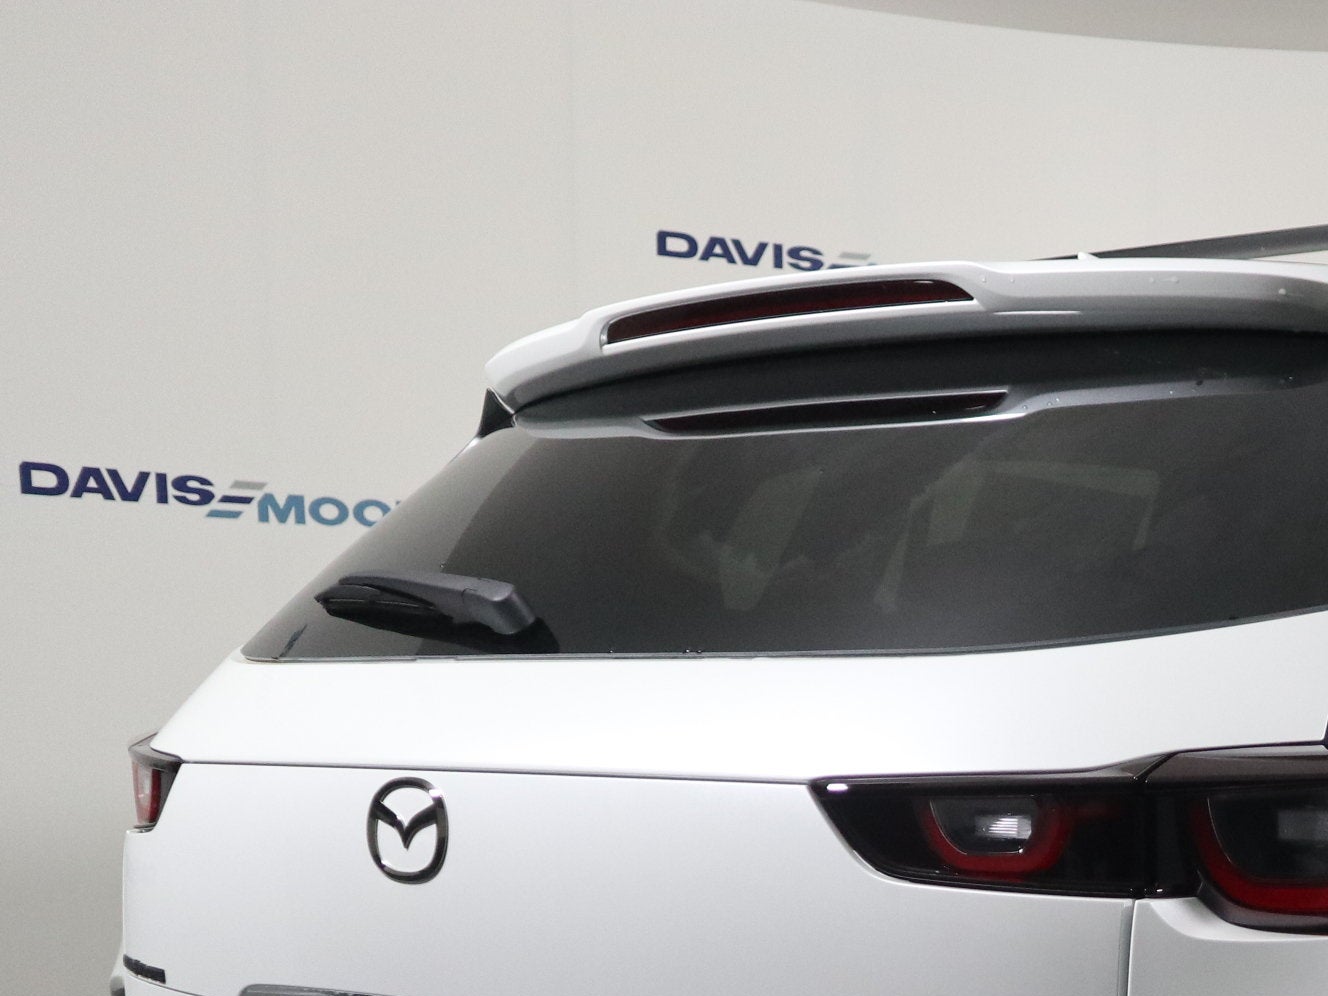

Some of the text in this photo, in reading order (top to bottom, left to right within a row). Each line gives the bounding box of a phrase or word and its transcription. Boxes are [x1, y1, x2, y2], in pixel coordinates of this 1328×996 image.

[656, 229, 825, 272] DAVIS
[18, 460, 400, 528] DAVIS MOO
